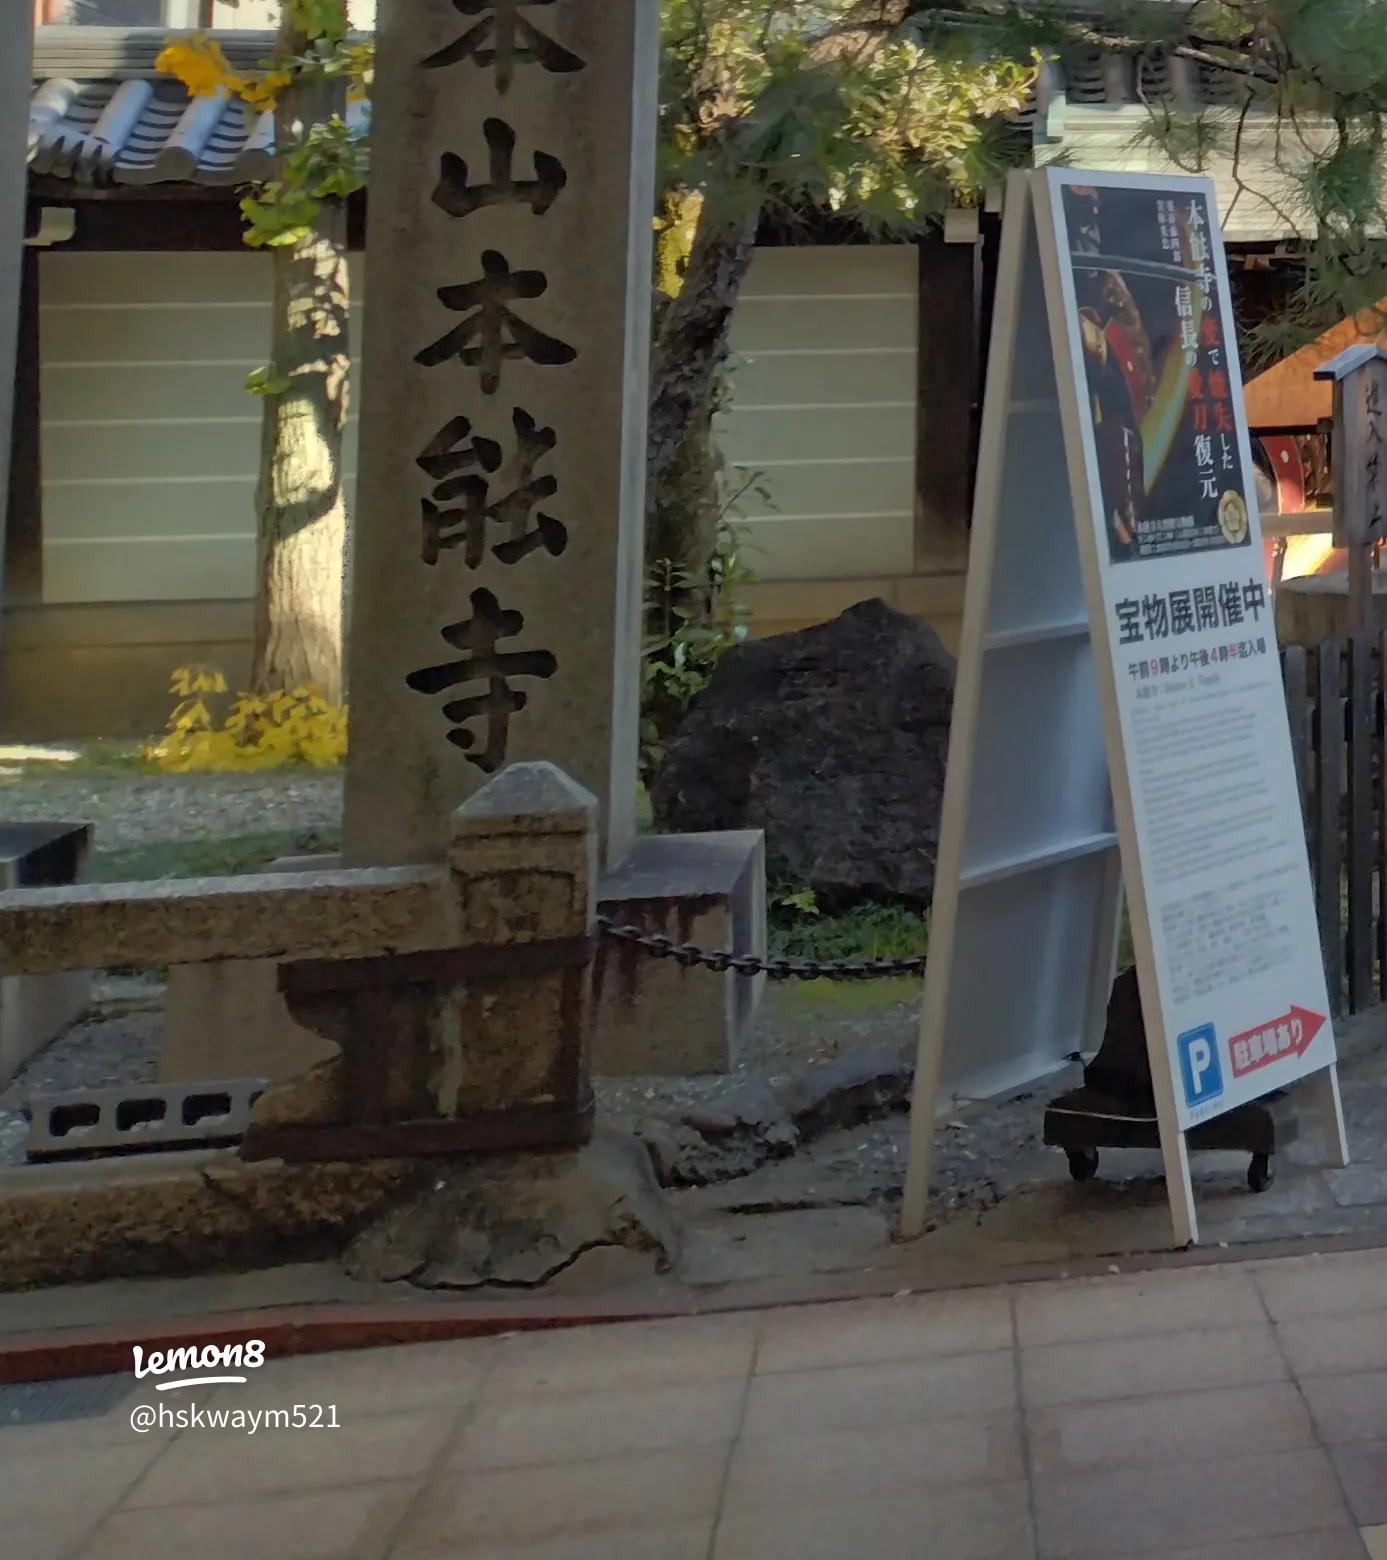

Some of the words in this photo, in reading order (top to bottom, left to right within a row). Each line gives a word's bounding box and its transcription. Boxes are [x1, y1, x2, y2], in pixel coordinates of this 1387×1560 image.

[1115, 577, 1266, 645] 宝物展開催中
[1188, 1038, 1211, 1095] P
[1233, 1018, 1303, 1070] 駐車場あり
